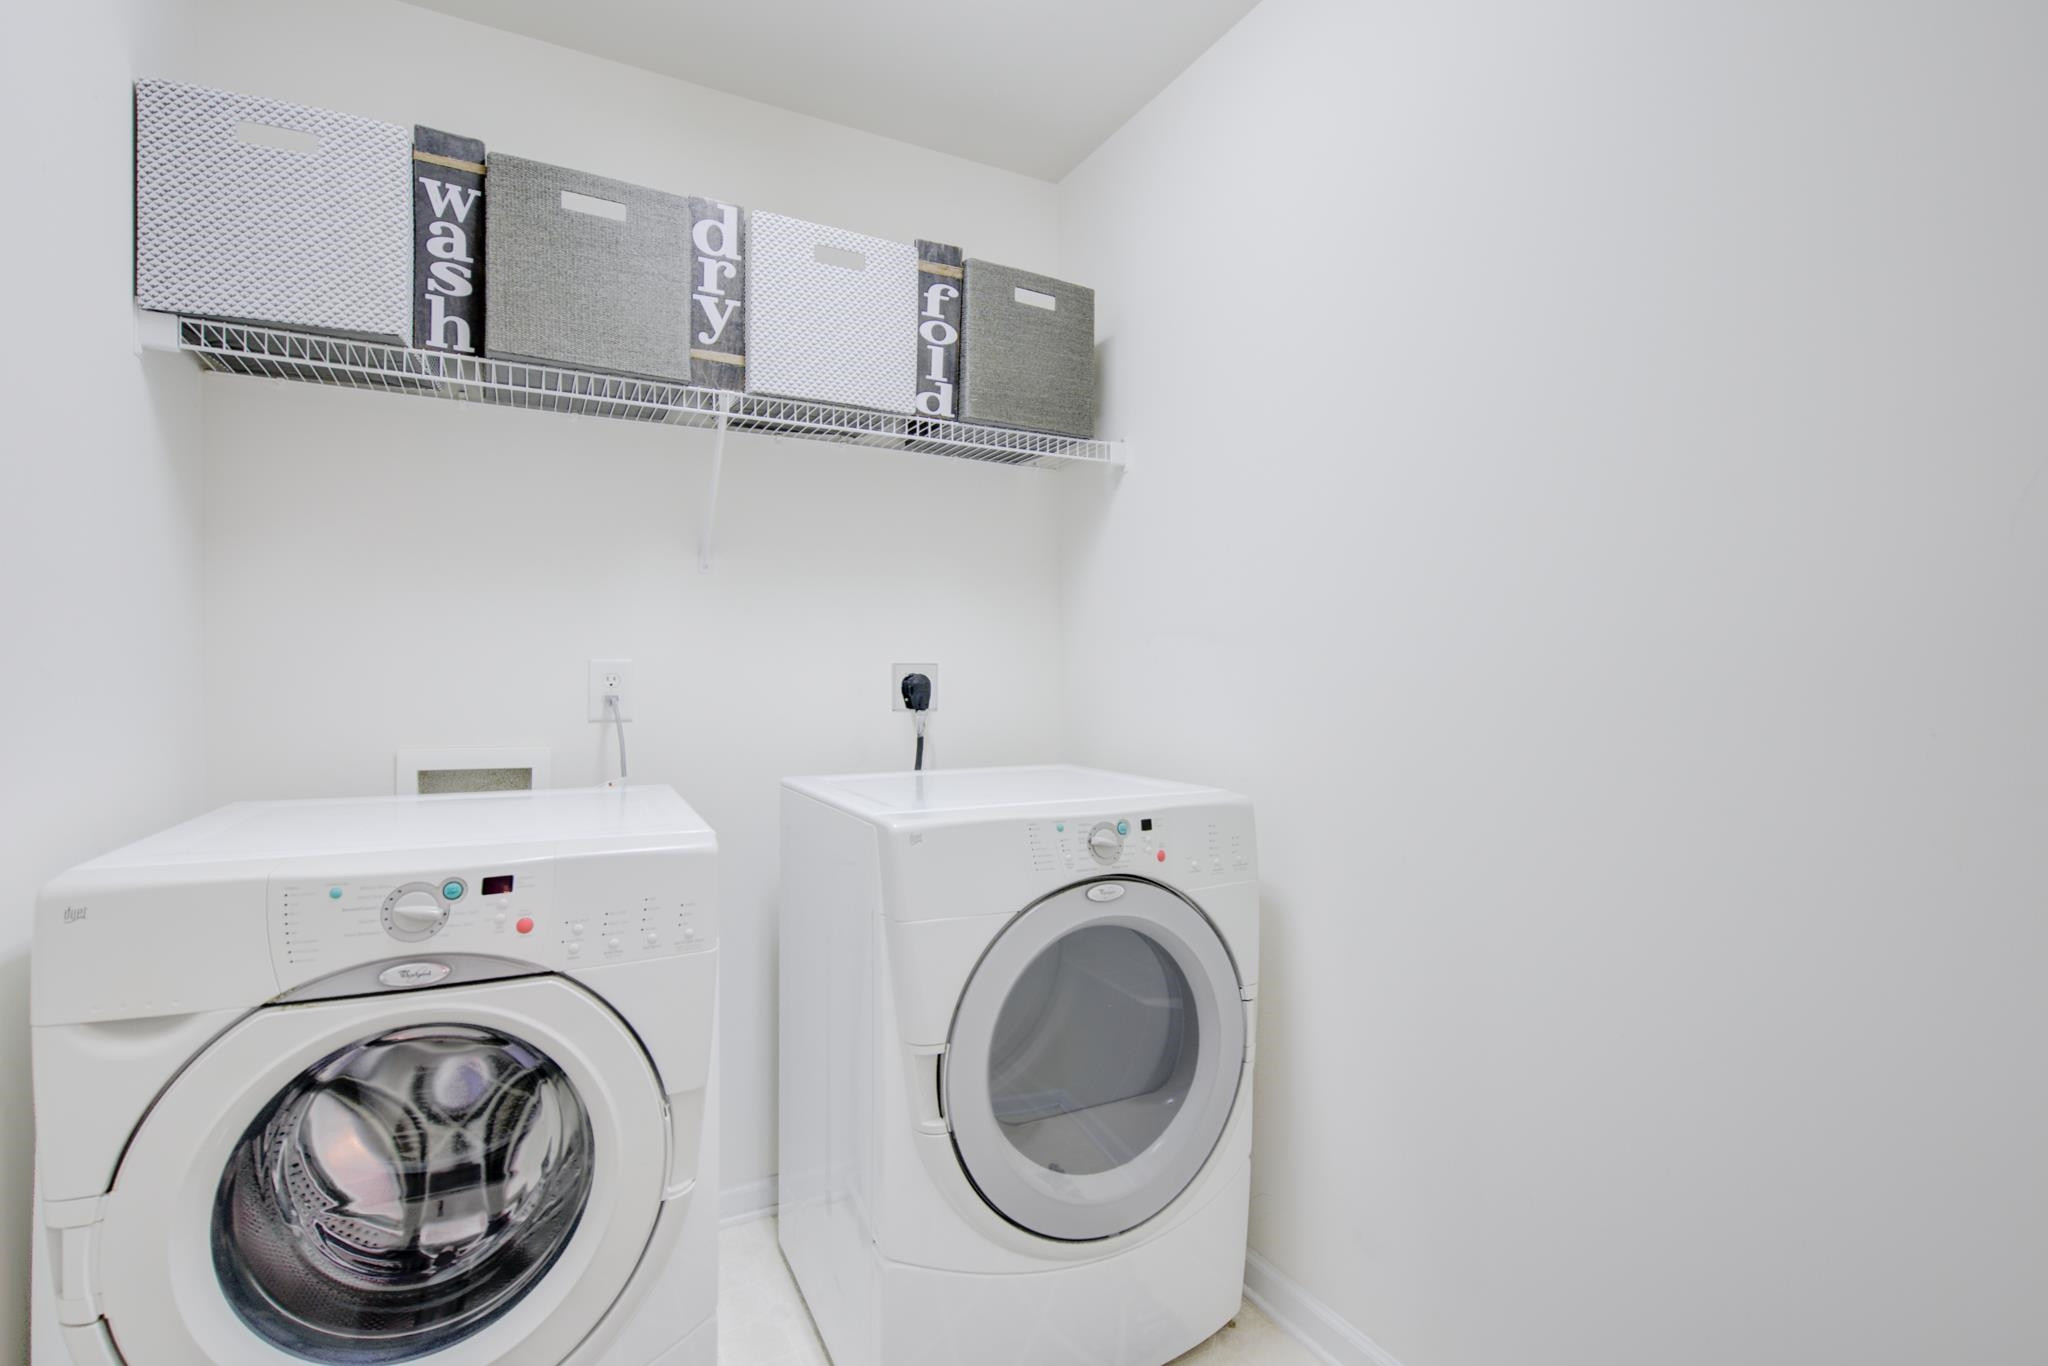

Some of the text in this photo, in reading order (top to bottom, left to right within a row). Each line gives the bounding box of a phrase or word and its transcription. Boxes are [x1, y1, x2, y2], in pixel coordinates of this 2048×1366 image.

[419, 176, 481, 353] wash
[692, 203, 742, 345] dry
[916, 283, 959, 418] fold
